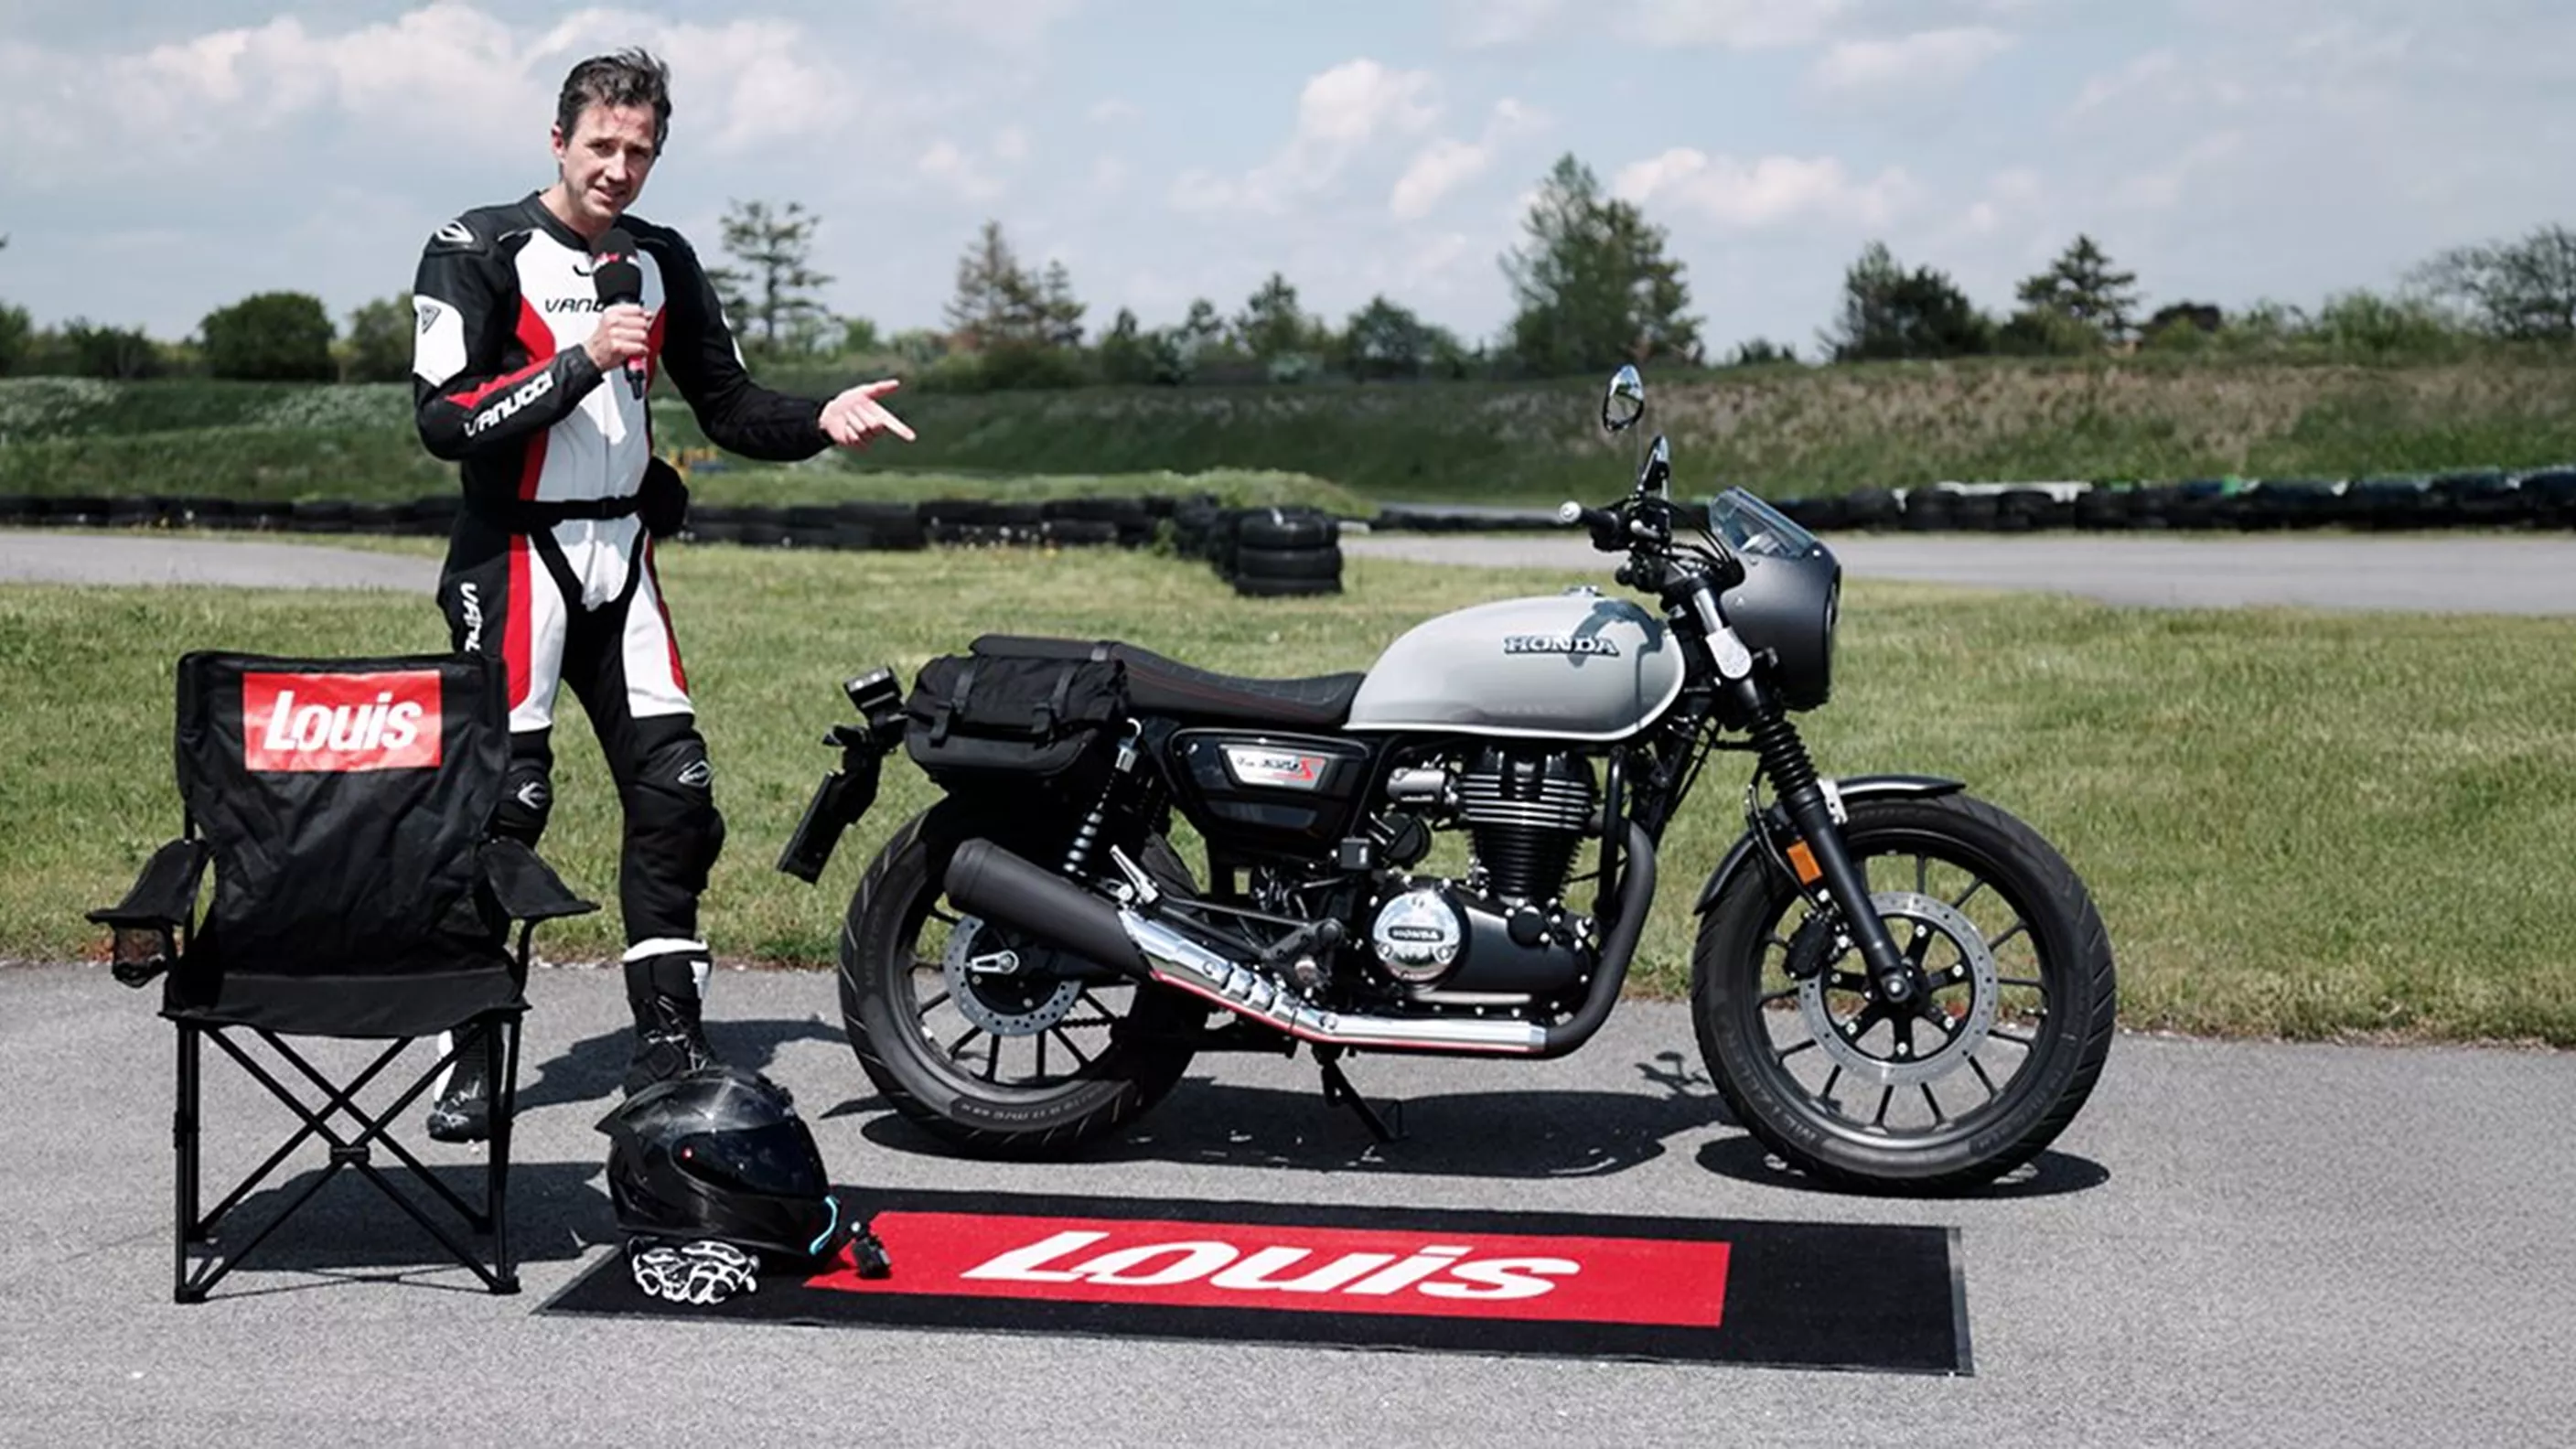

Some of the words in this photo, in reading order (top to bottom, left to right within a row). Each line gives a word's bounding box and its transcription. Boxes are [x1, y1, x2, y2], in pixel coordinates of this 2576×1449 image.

[463, 370, 554, 438] VANUCCI
[1504, 636, 1620, 657] HONDA
[263, 690, 424, 753] Louis
[960, 1230, 1580, 1300] Louis
